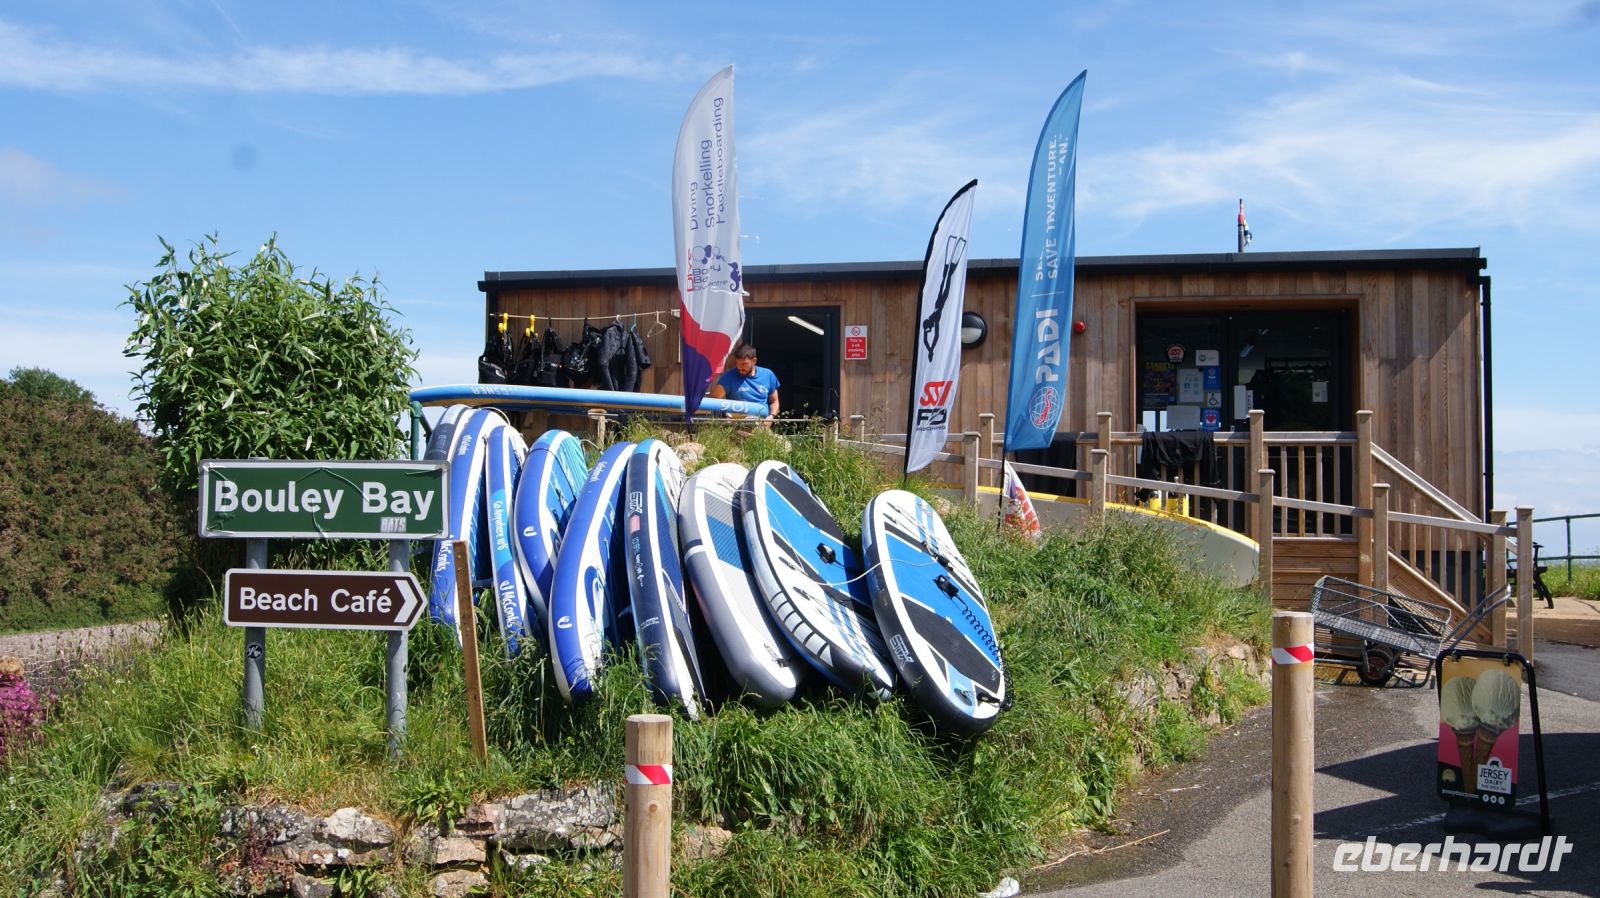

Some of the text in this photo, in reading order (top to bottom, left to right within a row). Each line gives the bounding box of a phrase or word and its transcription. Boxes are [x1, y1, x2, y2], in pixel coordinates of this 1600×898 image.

[700, 139, 715, 228] Snorkelling
[690, 181, 698, 230] Diving
[1035, 308, 1061, 385] PADI
[214, 480, 435, 521] Bouley Bay
[239, 586, 393, 614] Beach Café
[1479, 767, 1509, 781] JERSEY
[1484, 779, 1504, 787] DAIRY
